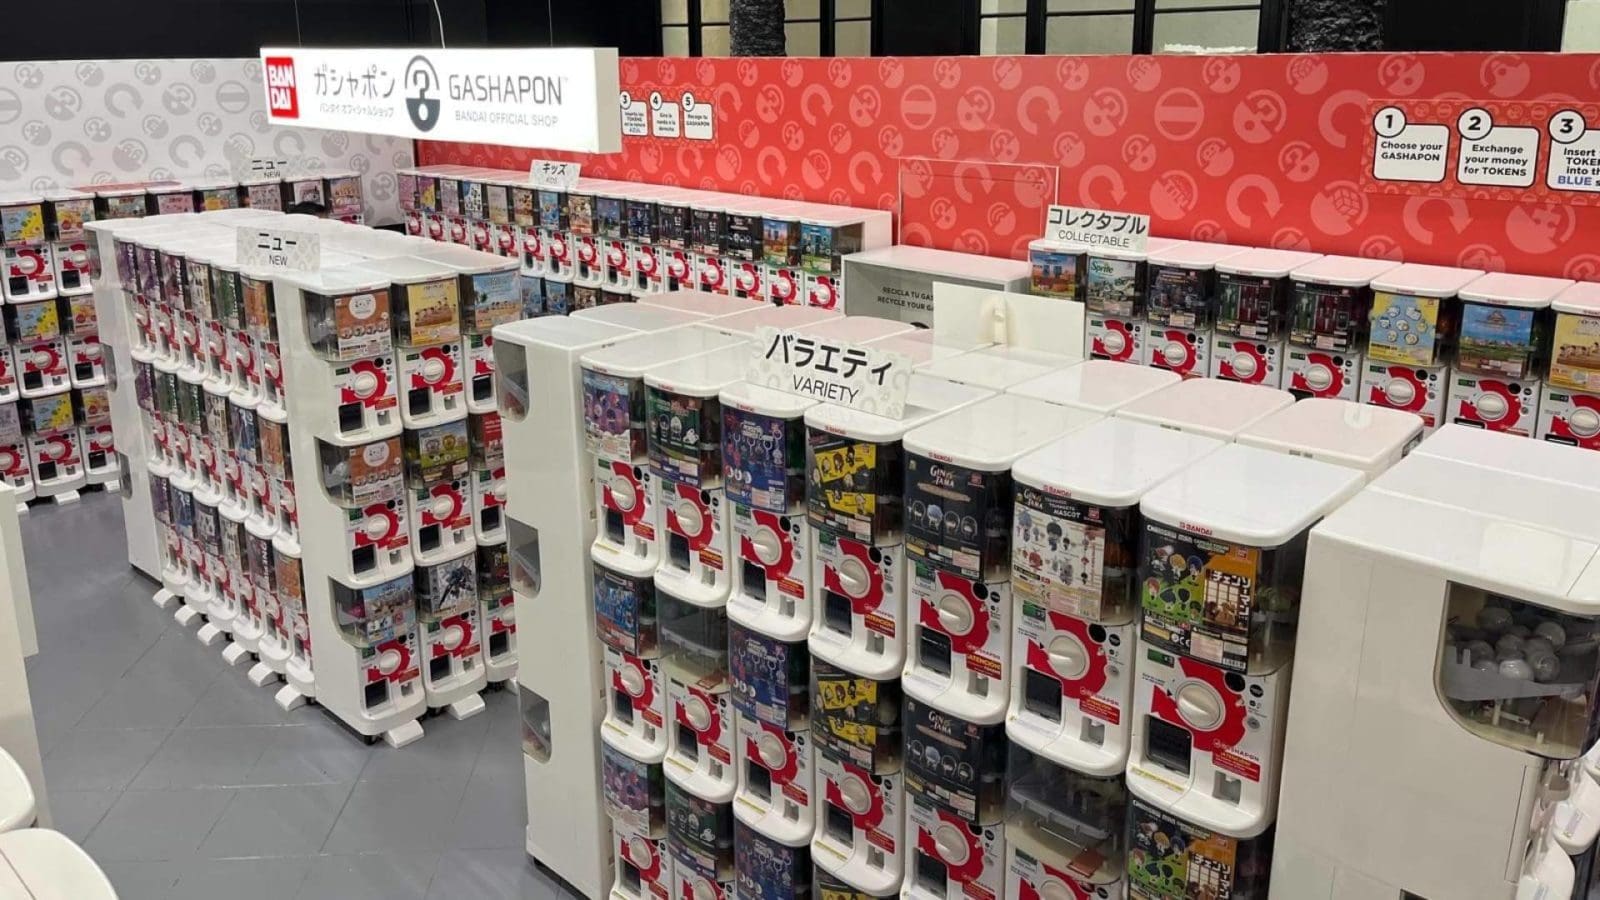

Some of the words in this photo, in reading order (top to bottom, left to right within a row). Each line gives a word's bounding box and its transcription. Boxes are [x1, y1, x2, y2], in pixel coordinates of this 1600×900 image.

[267, 64, 294, 87] BAN
[314, 64, 395, 99] ガシャポン
[449, 74, 562, 106] GASHAPON
[271, 87, 292, 110] DAI
[653, 96, 659, 105] 4
[685, 96, 691, 106] 5
[455, 110, 487, 123] BANDAI
[490, 112, 529, 126] OFFICIAL
[532, 114, 558, 127] SHOP
[1385, 114, 1393, 129] 1
[1468, 115, 1481, 131] 2
[1560, 118, 1574, 134] 3
[1381, 141, 1417, 150] Choose
[1420, 144, 1443, 152] your
[1472, 144, 1524, 155] Exchange
[1563, 147, 1596, 157] Insert
[1381, 152, 1440, 162] GASHAPON
[1465, 155, 1489, 164] your
[1491, 157, 1528, 167] money
[252, 160, 287, 170] ニュー
[543, 163, 568, 176] キッズ
[1464, 166, 1479, 175] for
[1482, 167, 1527, 177] TOKENS
[1566, 166, 1589, 175] into
[1557, 175, 1592, 186] BLUE
[1049, 208, 1146, 234] コレクタブル
[258, 233, 297, 251] ニュー
[1058, 230, 1130, 248] COLLECTABLE
[269, 255, 289, 266] NEW
[1091, 261, 1114, 274] Sprite
[882, 286, 910, 297] RECICLA
[911, 291, 920, 299] TU
[877, 296, 905, 307] RECYCLE
[907, 301, 925, 310] YOUR
[765, 334, 892, 386] バラエティ
[793, 374, 859, 404] VARIETY
[1053, 509, 1081, 519] MASCOT
[1185, 524, 1213, 536] BANDAI
